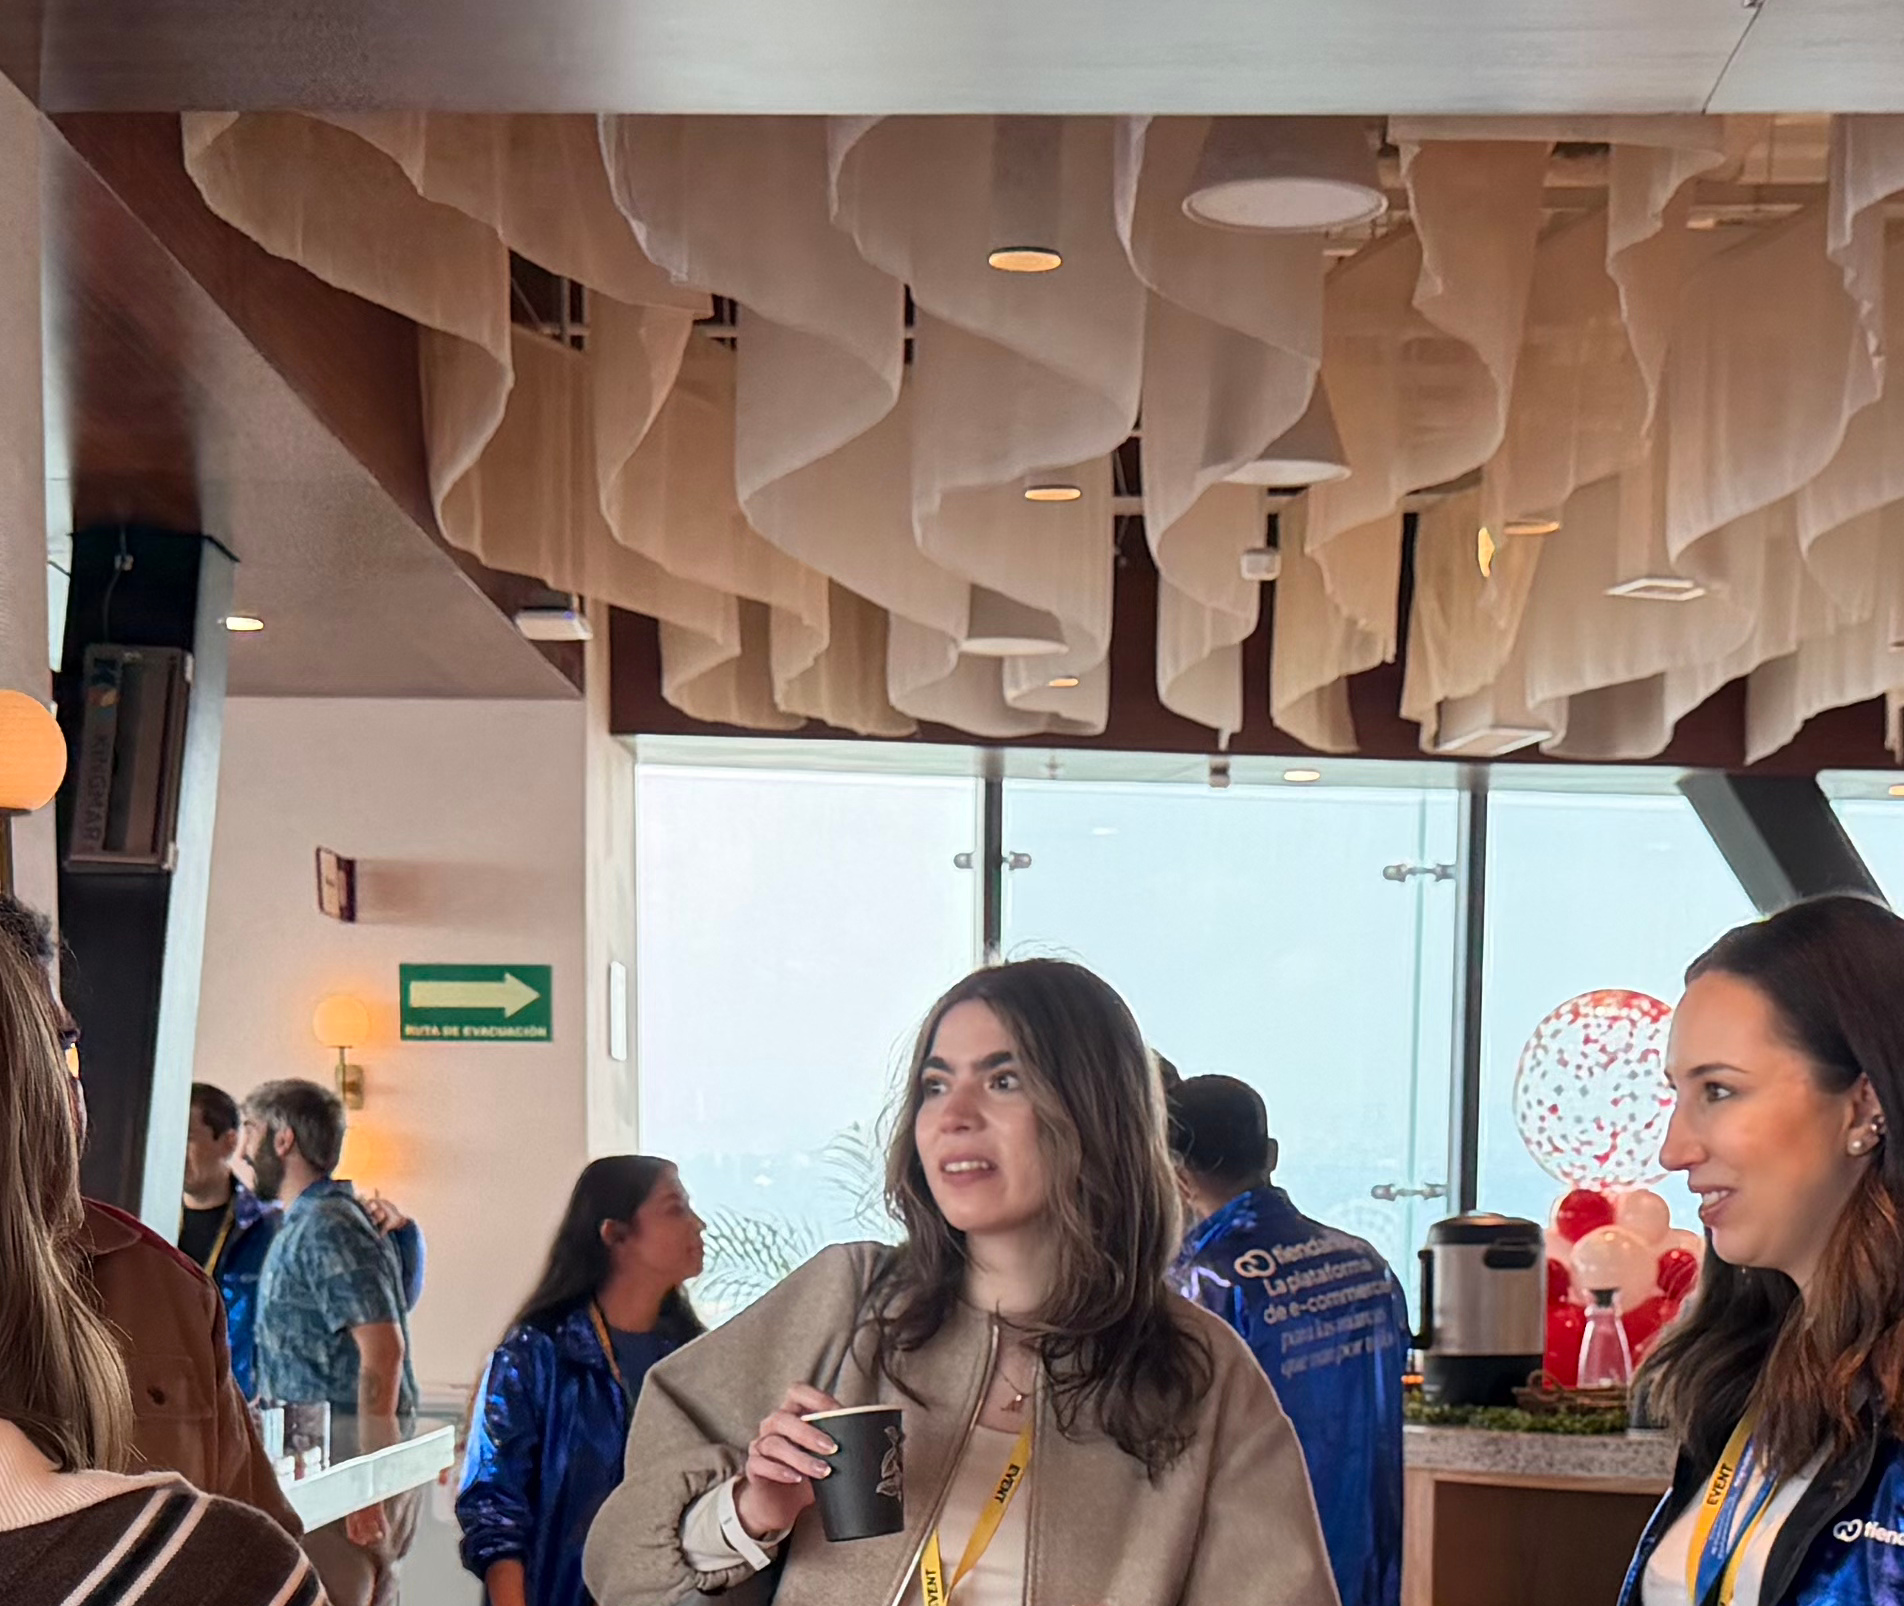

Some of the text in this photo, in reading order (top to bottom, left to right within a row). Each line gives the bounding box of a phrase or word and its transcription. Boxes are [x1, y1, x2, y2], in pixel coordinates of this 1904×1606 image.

[405, 1025, 440, 1036] RUTA
[442, 1025, 460, 1036] DE
[993, 1463, 1020, 1504] EVENT
[1706, 1463, 1733, 1506] EVENT
